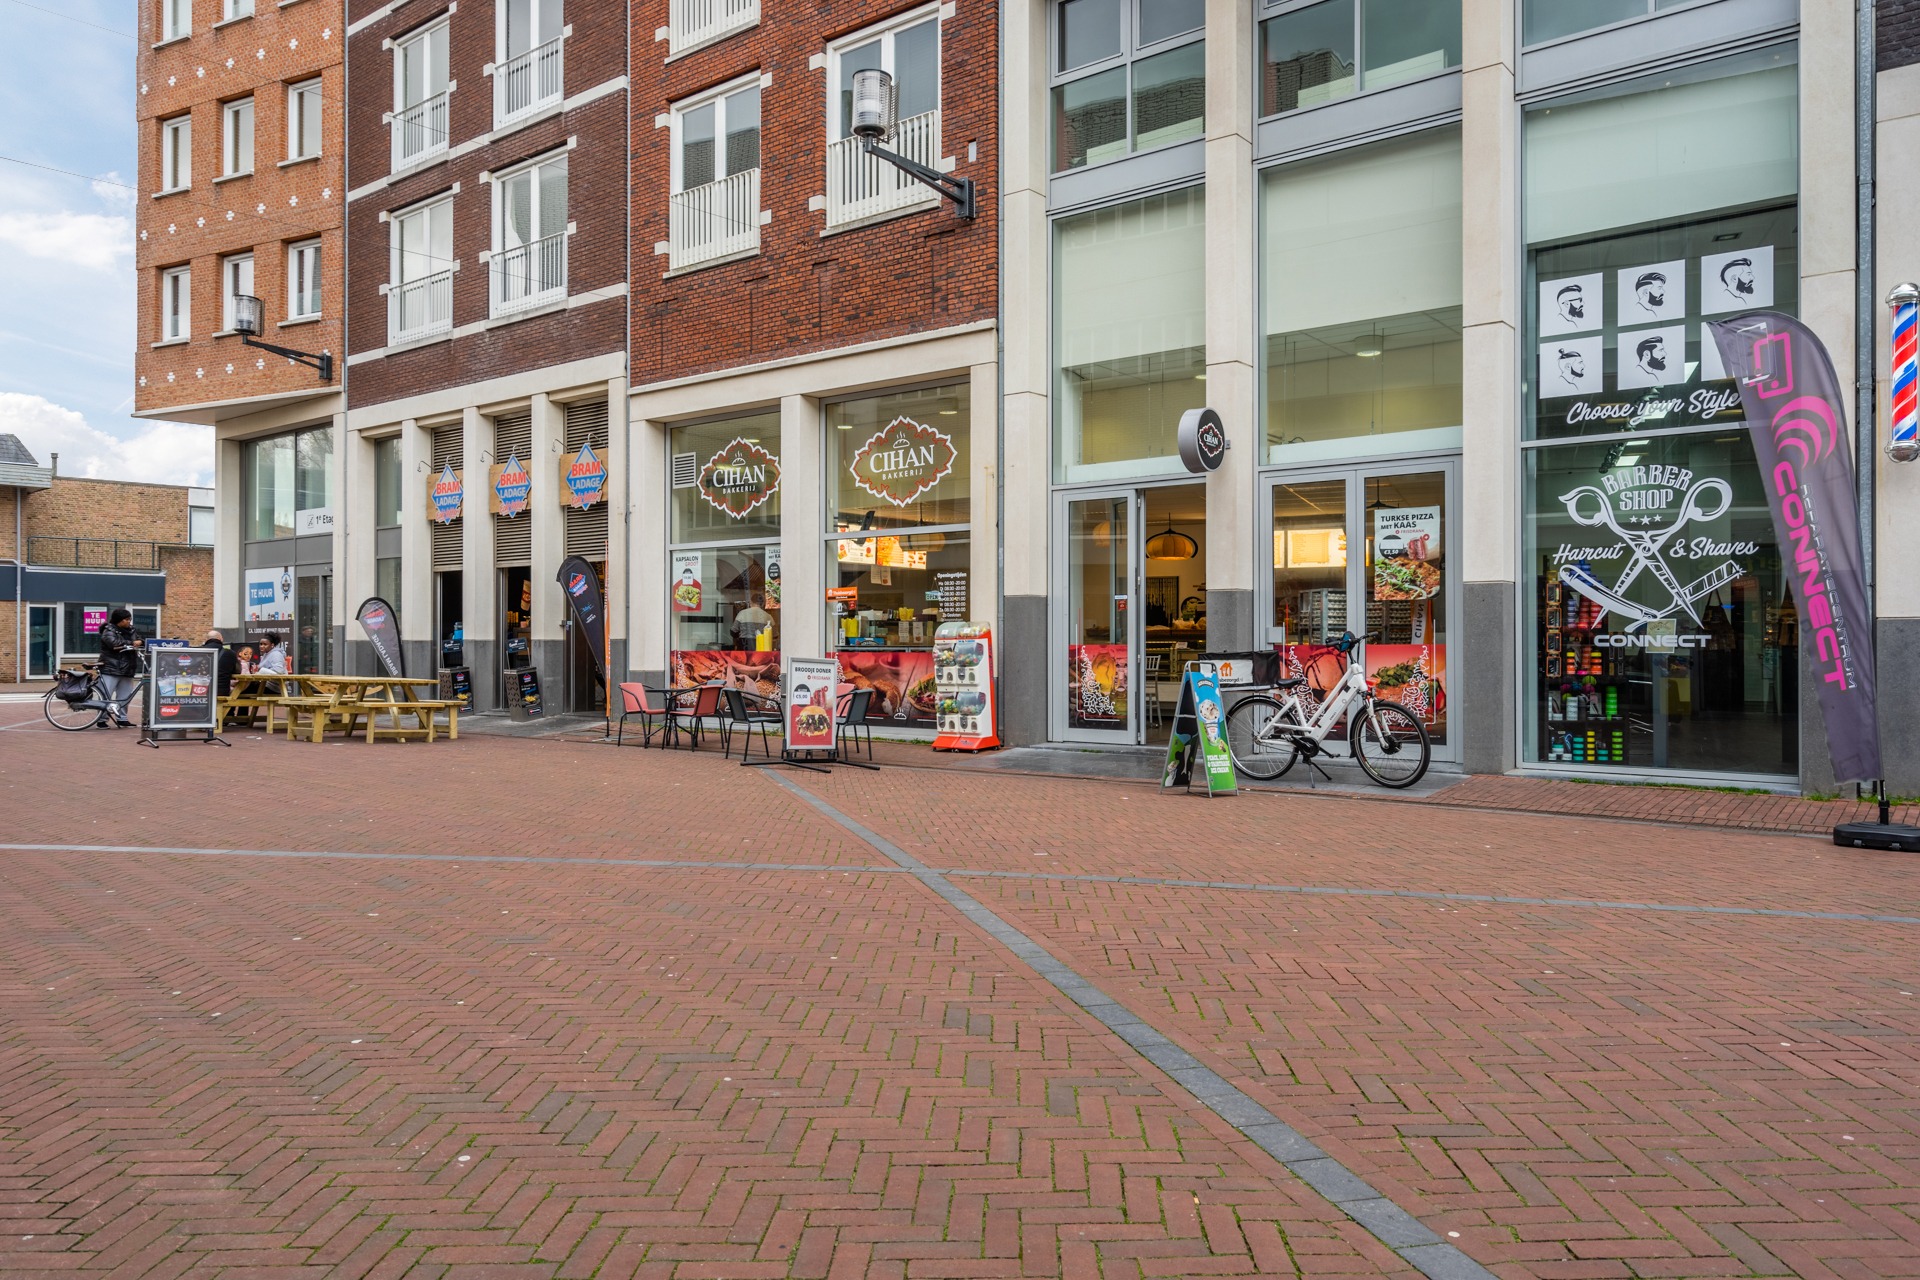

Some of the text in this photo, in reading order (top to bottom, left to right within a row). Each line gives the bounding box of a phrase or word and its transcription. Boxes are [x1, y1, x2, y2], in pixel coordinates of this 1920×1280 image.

[1566, 388, 1743, 426] Choose your Style
[870, 444, 935, 473] CIHAN
[571, 461, 601, 477] BRAM
[712, 464, 766, 488] CIHAN
[882, 468, 923, 481] BAKKERIJ
[500, 471, 527, 487] BRAM
[571, 477, 601, 490] LADAGE
[1601, 464, 1694, 496] BARBER
[436, 481, 460, 495] BRAM
[500, 486, 527, 499] LADAGE
[722, 485, 756, 495] BAKKERIJ
[435, 494, 460, 507] LADAGE
[1619, 488, 1674, 511] SHOP
[1380, 512, 1435, 523] TURKSE PIZZA
[1393, 520, 1418, 529] KAAS
[1552, 543, 1627, 565] Haircut
[1669, 536, 1760, 560] & Shaves
[675, 555, 699, 563] KAPSALON
[1773, 460, 1848, 691] CONNECT
[251, 588, 273, 598] TE HUUR
[1593, 634, 1713, 648] CONNECT
[794, 666, 815, 674] BROODJE
